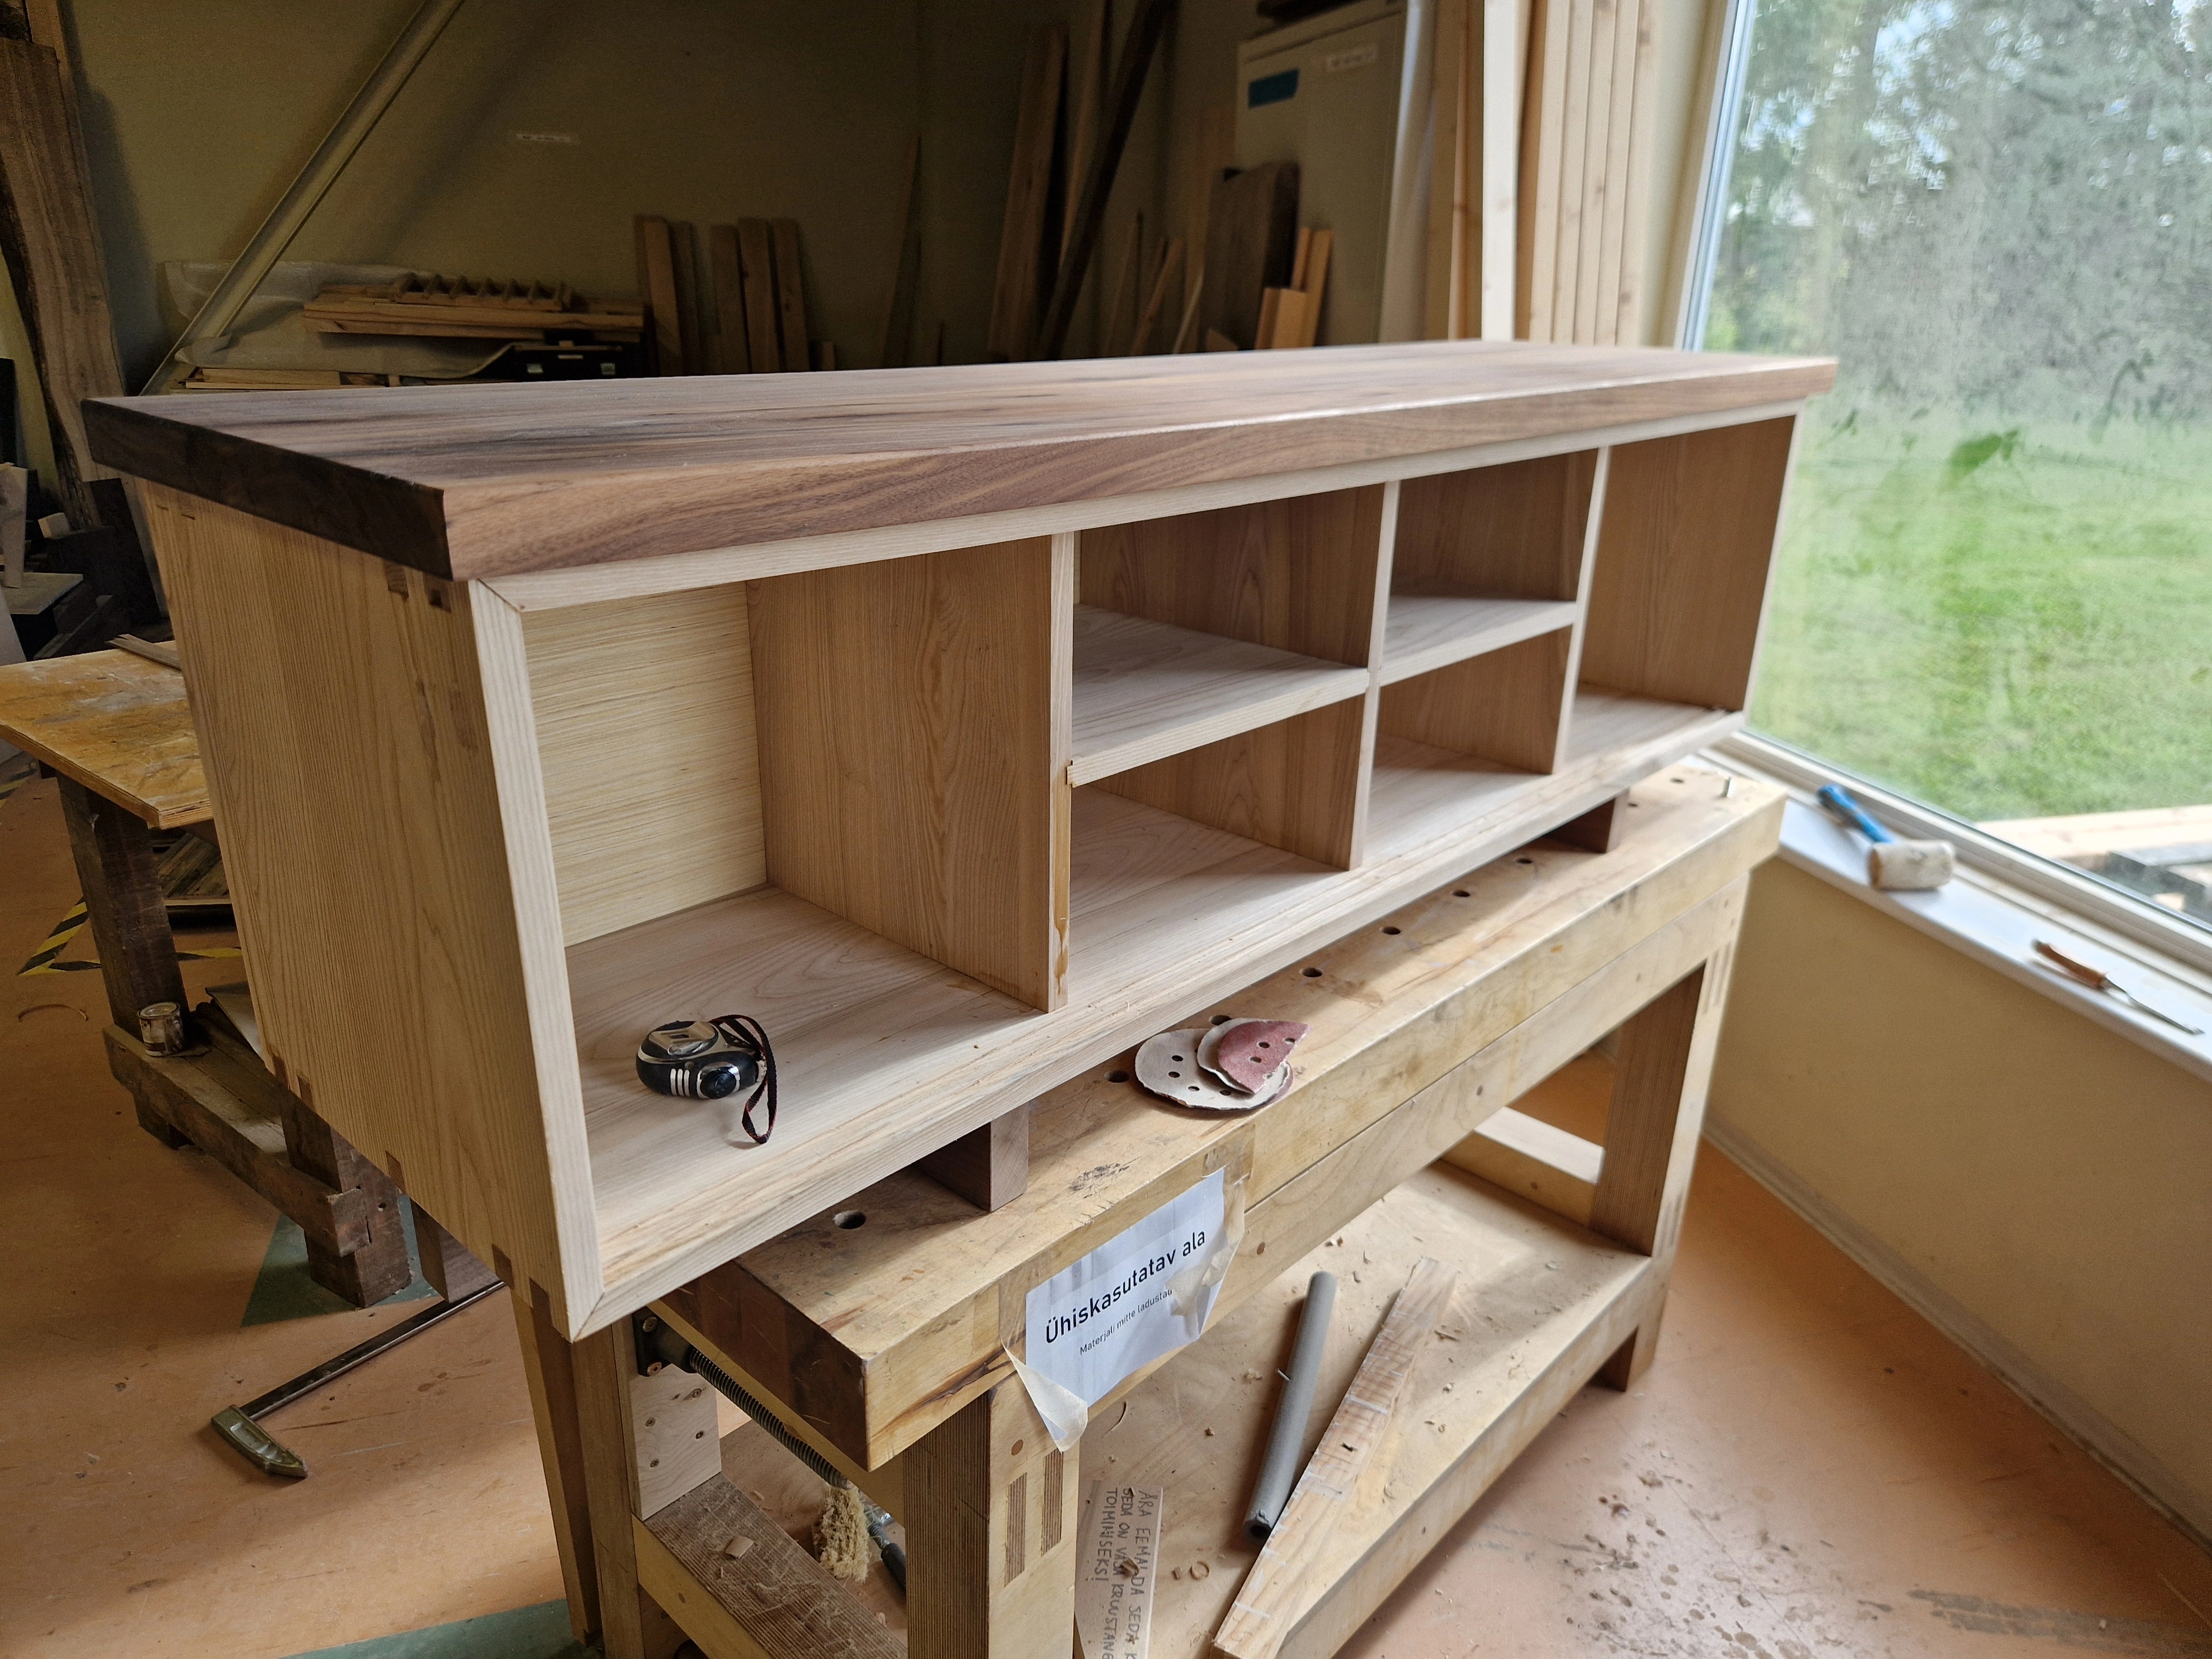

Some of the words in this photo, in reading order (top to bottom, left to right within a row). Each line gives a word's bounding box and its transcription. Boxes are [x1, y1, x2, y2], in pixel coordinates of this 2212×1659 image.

[1046, 1248, 1176, 1344] Ühiskasutatav
[1182, 1230, 1206, 1257] ala
[1079, 1323, 1115, 1355] Materjali
[1117, 1310, 1135, 1329] mitte
[1120, 1488, 1134, 1516] SEDA
[1117, 1522, 1130, 1538] ON
[1125, 1605, 1141, 1643] SEDA
